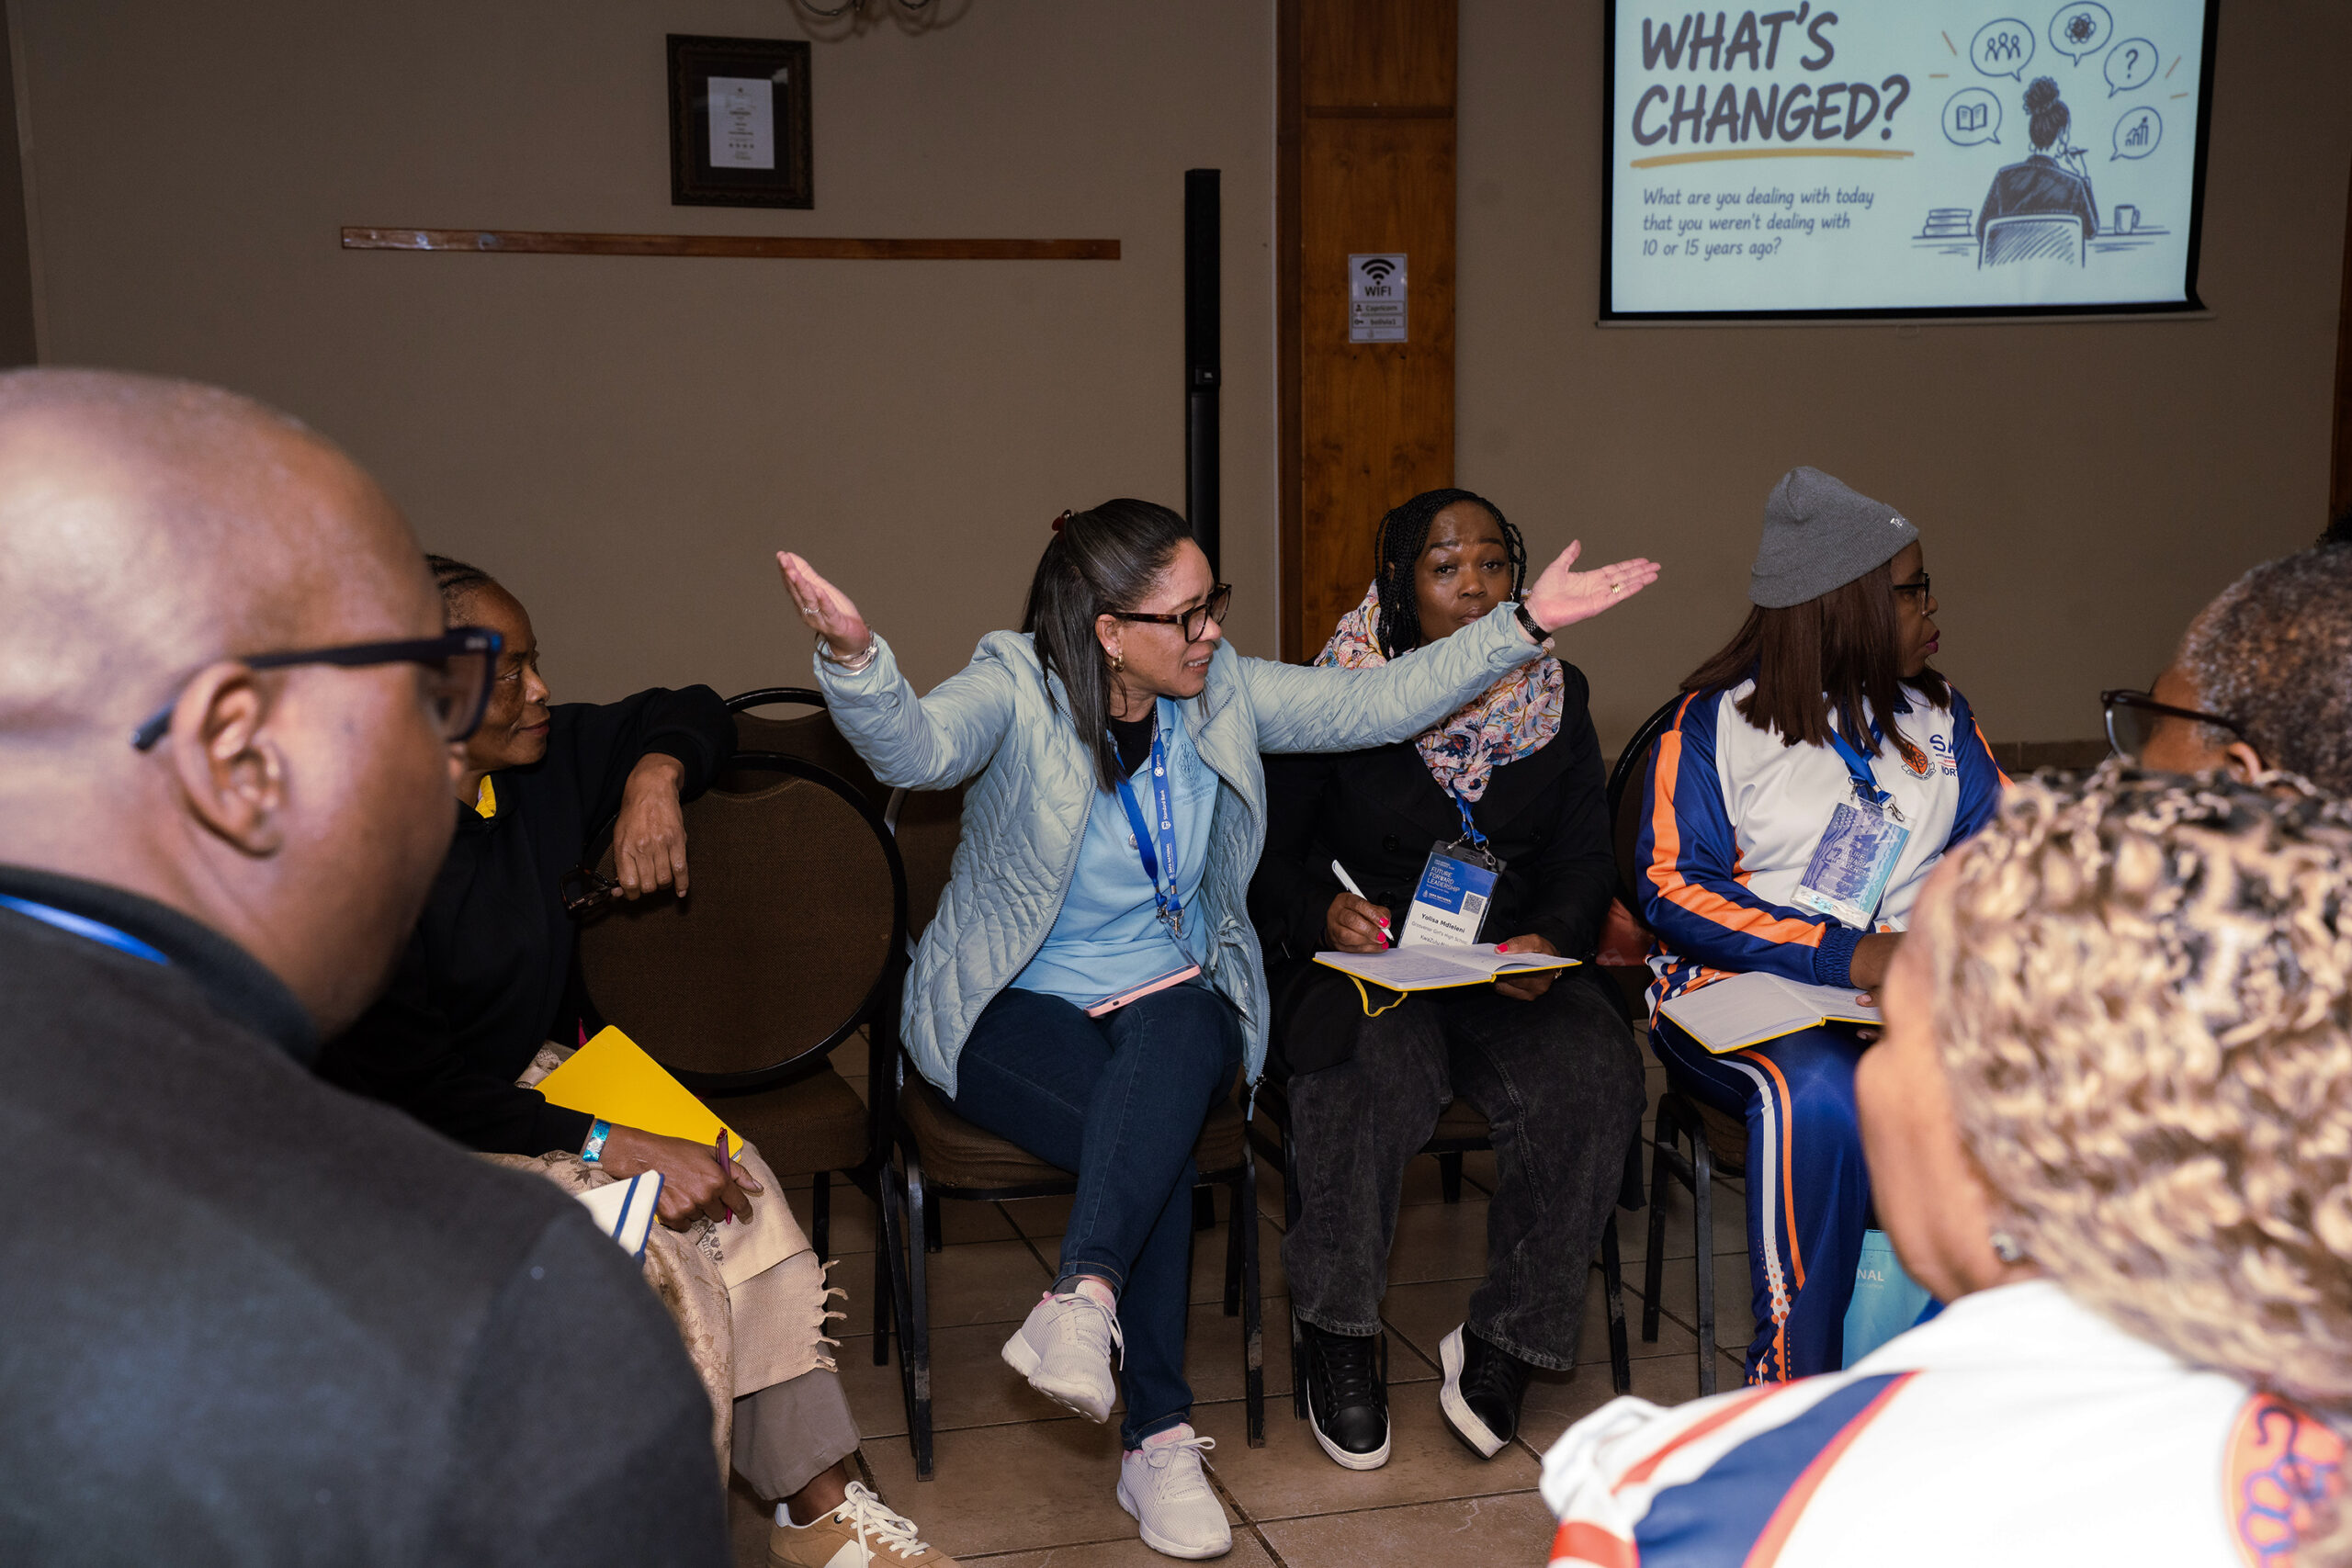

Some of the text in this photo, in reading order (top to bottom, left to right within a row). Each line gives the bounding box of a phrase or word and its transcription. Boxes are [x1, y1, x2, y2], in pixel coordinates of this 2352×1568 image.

[1643, 1, 1838, 71] WHAT'S
[1632, 73, 1910, 146] CHANGED?
[1644, 186, 1874, 211] What are you dealing with today
[1643, 212, 1850, 236] that you weren't dealing with
[1643, 237, 1782, 262] 10 or 15 years ago?
[1365, 286, 1391, 296] WIFI
[1429, 872, 1454, 885] FORWARD
[1430, 866, 1453, 878] FUTURE
[1427, 878, 1461, 892] LEADERSHIP
[1421, 913, 1440, 924] Yolisa
[1857, 1269, 1884, 1281] NAL
